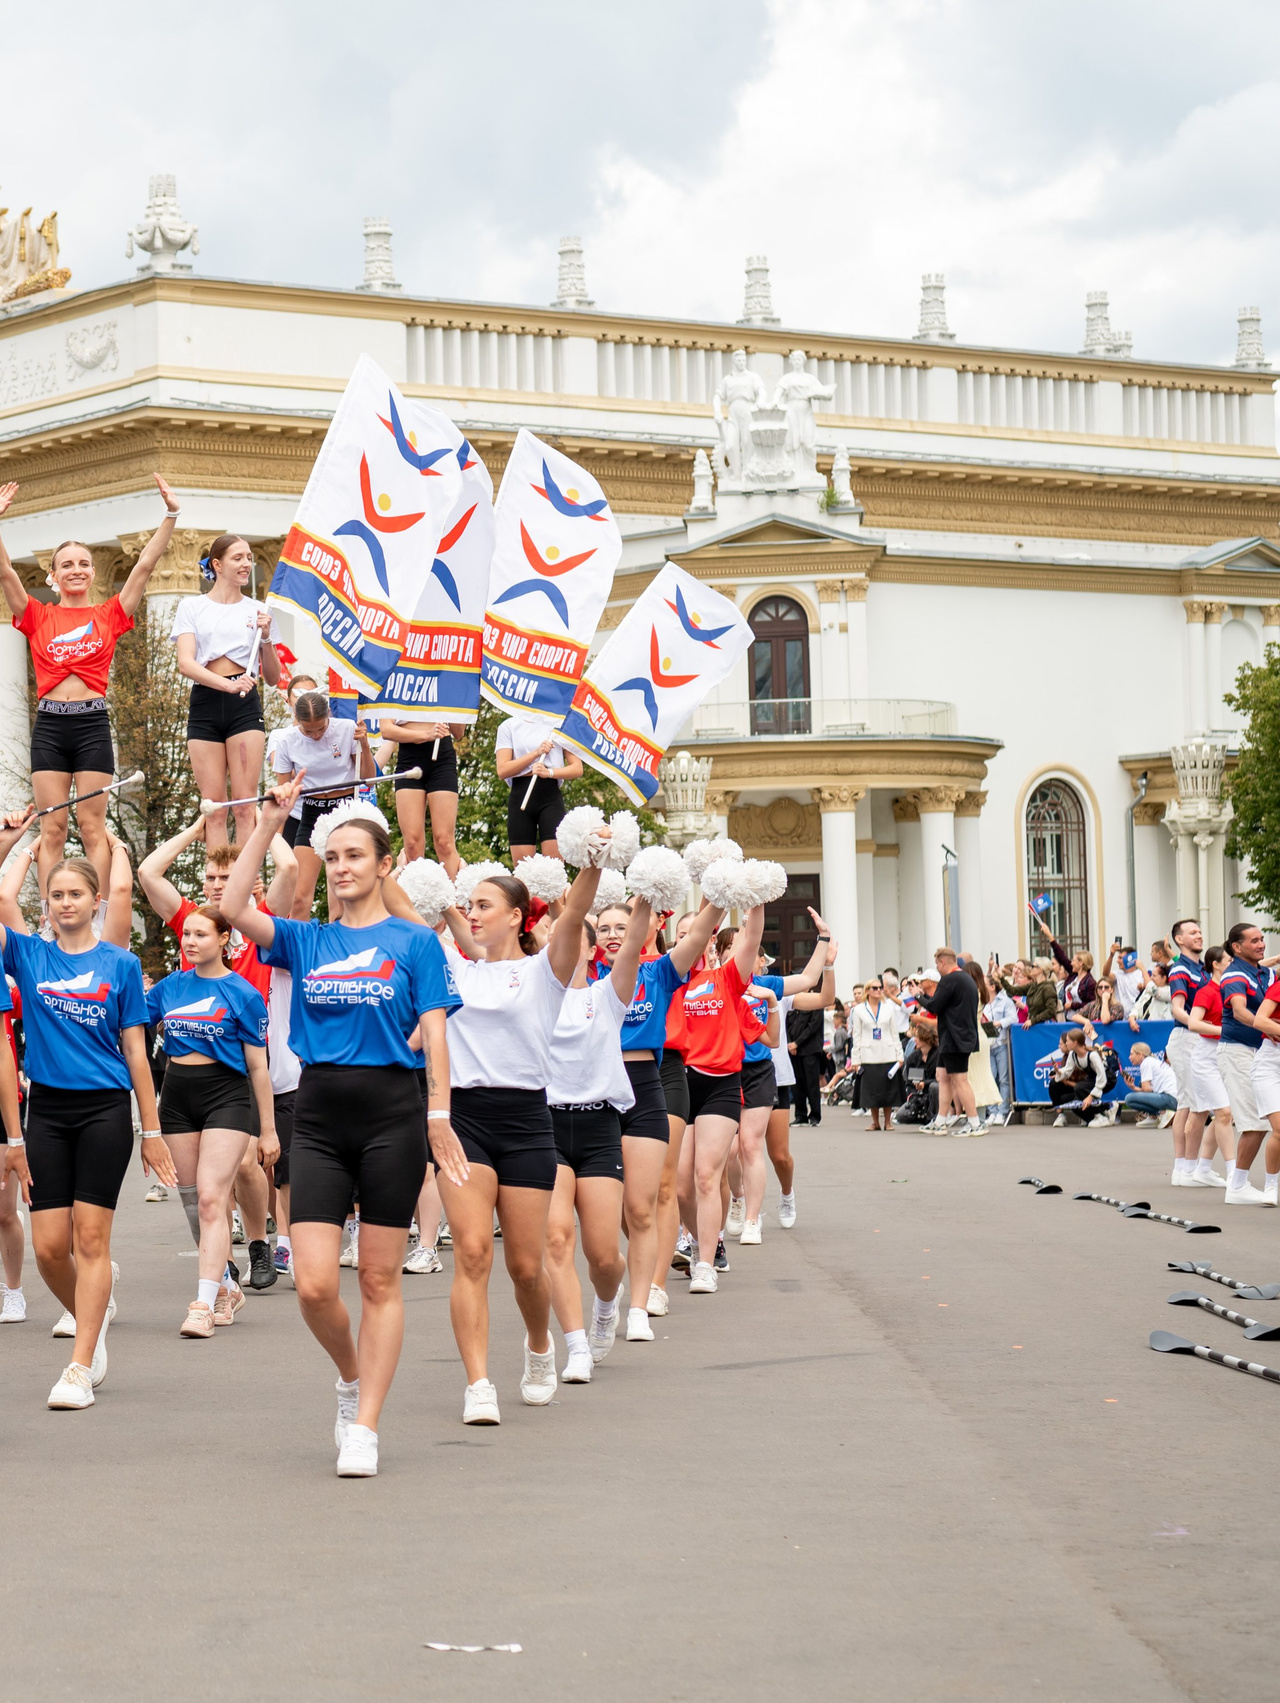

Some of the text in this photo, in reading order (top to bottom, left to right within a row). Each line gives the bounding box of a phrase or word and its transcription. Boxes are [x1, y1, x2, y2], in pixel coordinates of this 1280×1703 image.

[301, 541, 400, 640] СОЮЗ ЧИ ПОРТА
[404, 632, 475, 664] ЧИР СПОРТА
[501, 631, 528, 661] ЧИР
[527, 641, 578, 674] СПОРТА
[384, 672, 439, 703] РОССИИ
[306, 994, 381, 1007] ШЕСТВИЕ
